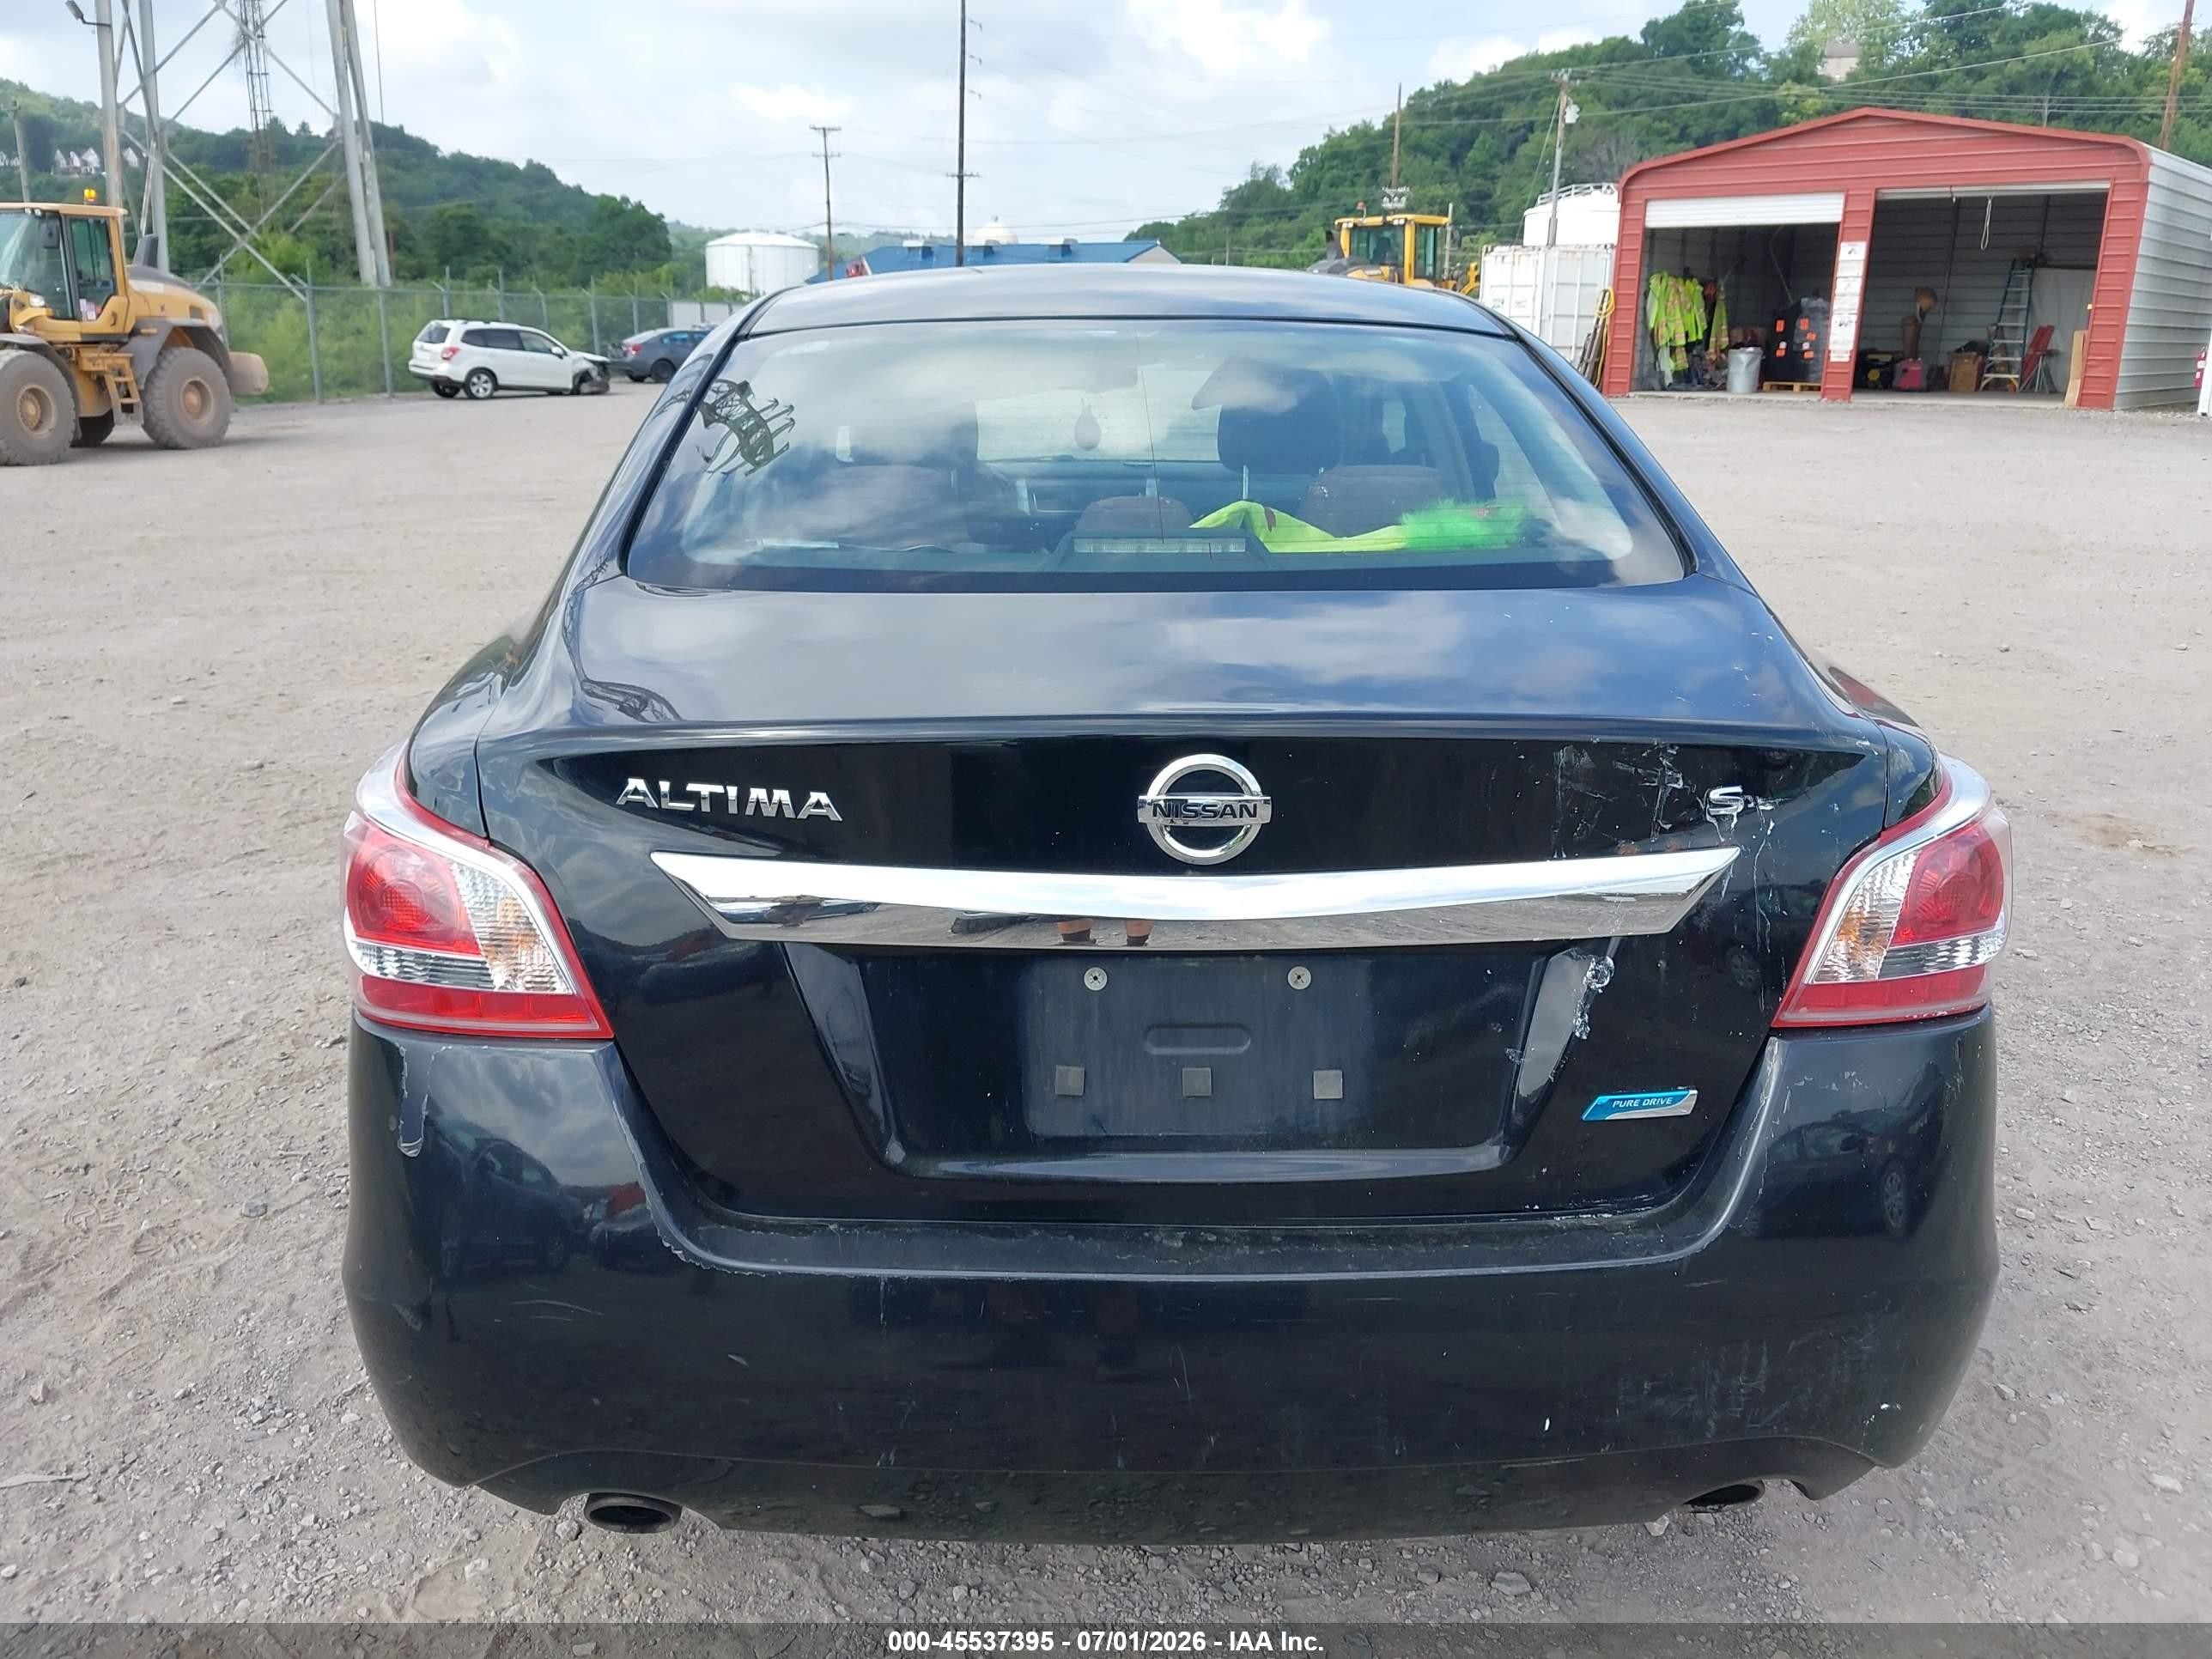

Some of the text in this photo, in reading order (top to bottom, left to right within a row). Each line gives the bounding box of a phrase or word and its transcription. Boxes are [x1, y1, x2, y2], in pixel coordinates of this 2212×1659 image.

[616, 777, 843, 822] ALTIMA
[1152, 802, 1258, 819] NISSAN
[1709, 785, 1745, 815] S
[1612, 1097, 1674, 1109] PURE DRIVE
